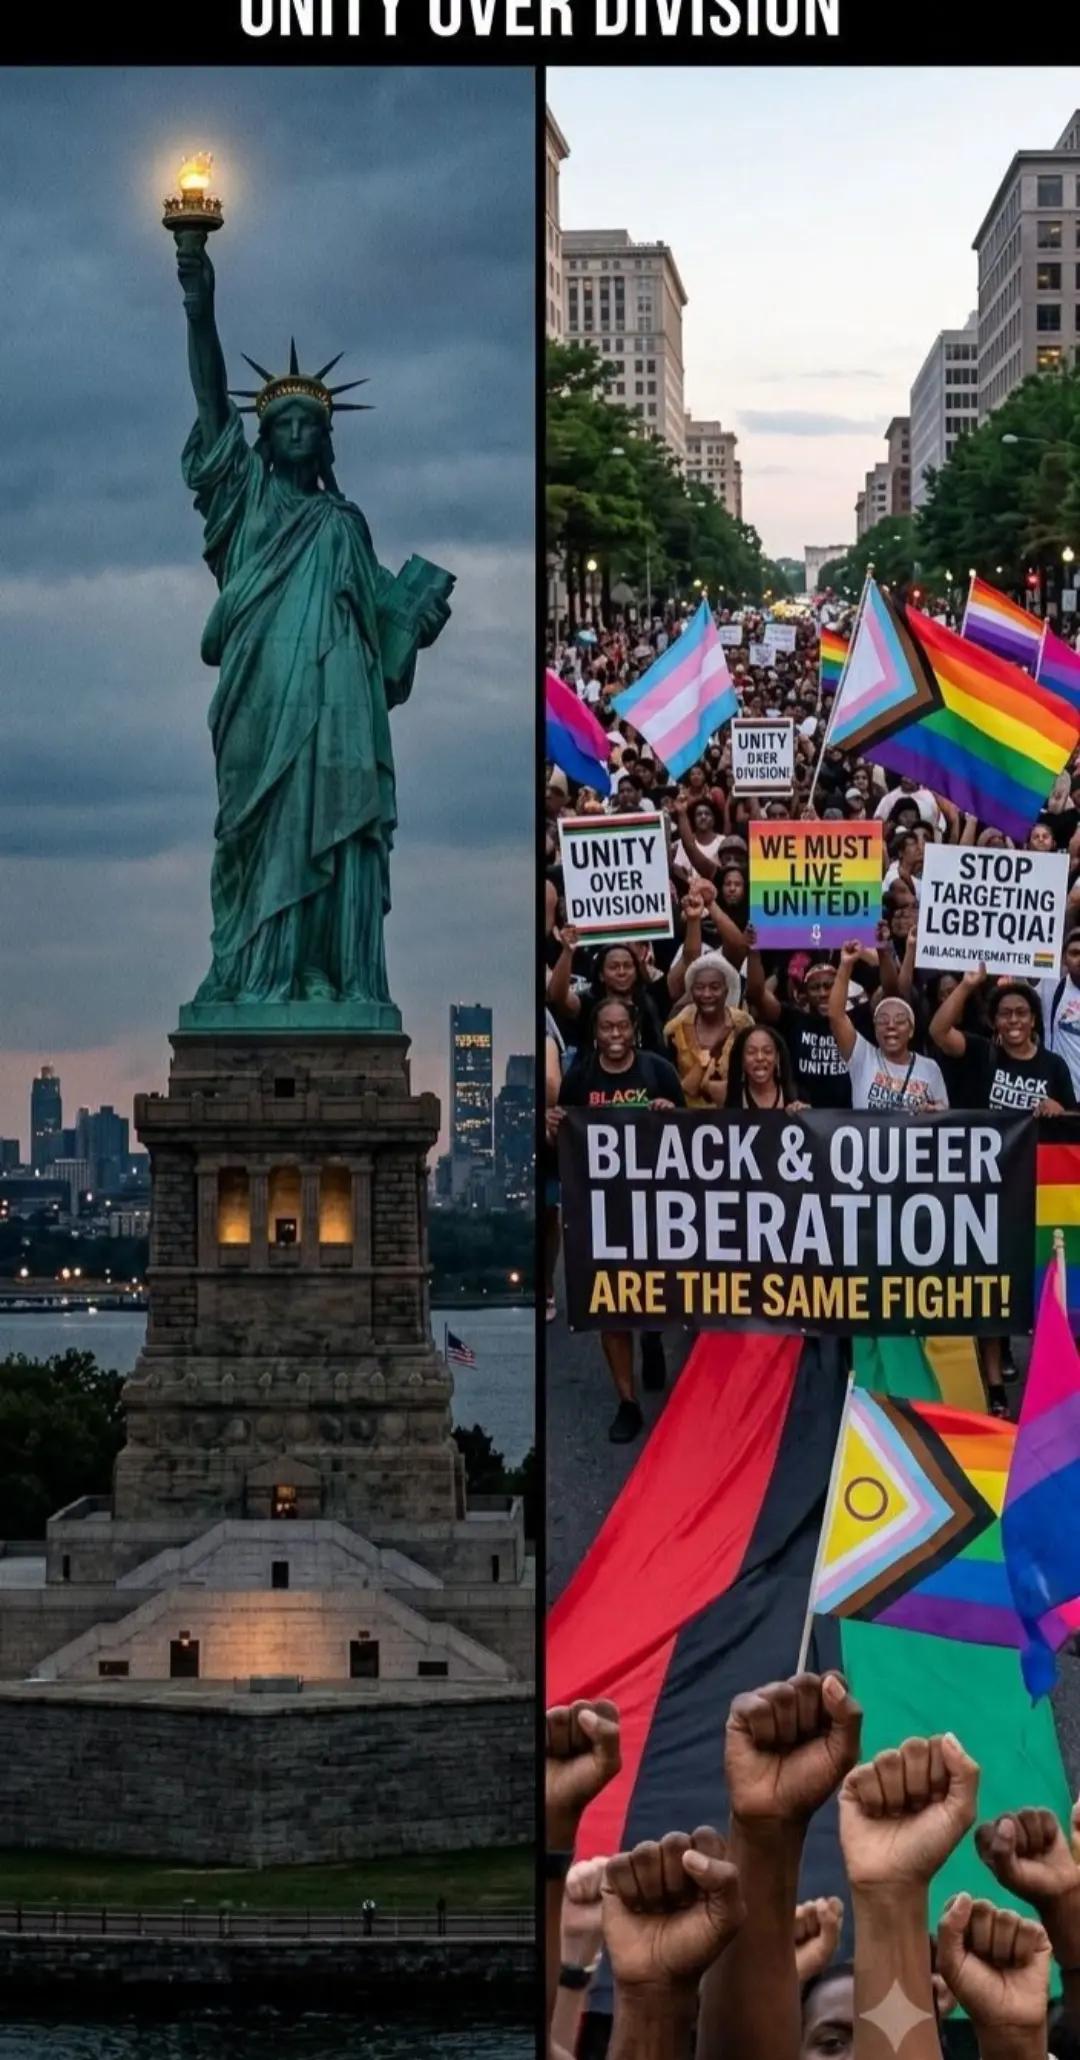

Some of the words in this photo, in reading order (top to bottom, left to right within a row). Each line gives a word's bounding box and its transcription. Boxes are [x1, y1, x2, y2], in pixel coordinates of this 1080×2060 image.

[738, 732, 787, 750] UNITY
[570, 836, 656, 869] UNITY
[759, 835, 797, 859] WE
[805, 835, 872, 859] MUST
[590, 870, 643, 893] OVER
[790, 863, 842, 887] LIVE
[959, 852, 1033, 883] STOP
[571, 892, 666, 919] DIVISION!
[763, 890, 869, 916] UNITED!
[931, 880, 1055, 912] TARGETING
[926, 906, 1055, 944] LGBTQIA!
[995, 1069, 1048, 1094] BLACK
[586, 1124, 762, 1181] BLACK
[777, 1125, 813, 1182] &
[830, 1127, 1002, 1191] QUEER
[591, 1190, 998, 1266] LIBERATION
[588, 1270, 666, 1314] ARE
[677, 1272, 752, 1315] THE
[762, 1273, 870, 1319] SAME
[881, 1275, 1010, 1319] FIGHT!
